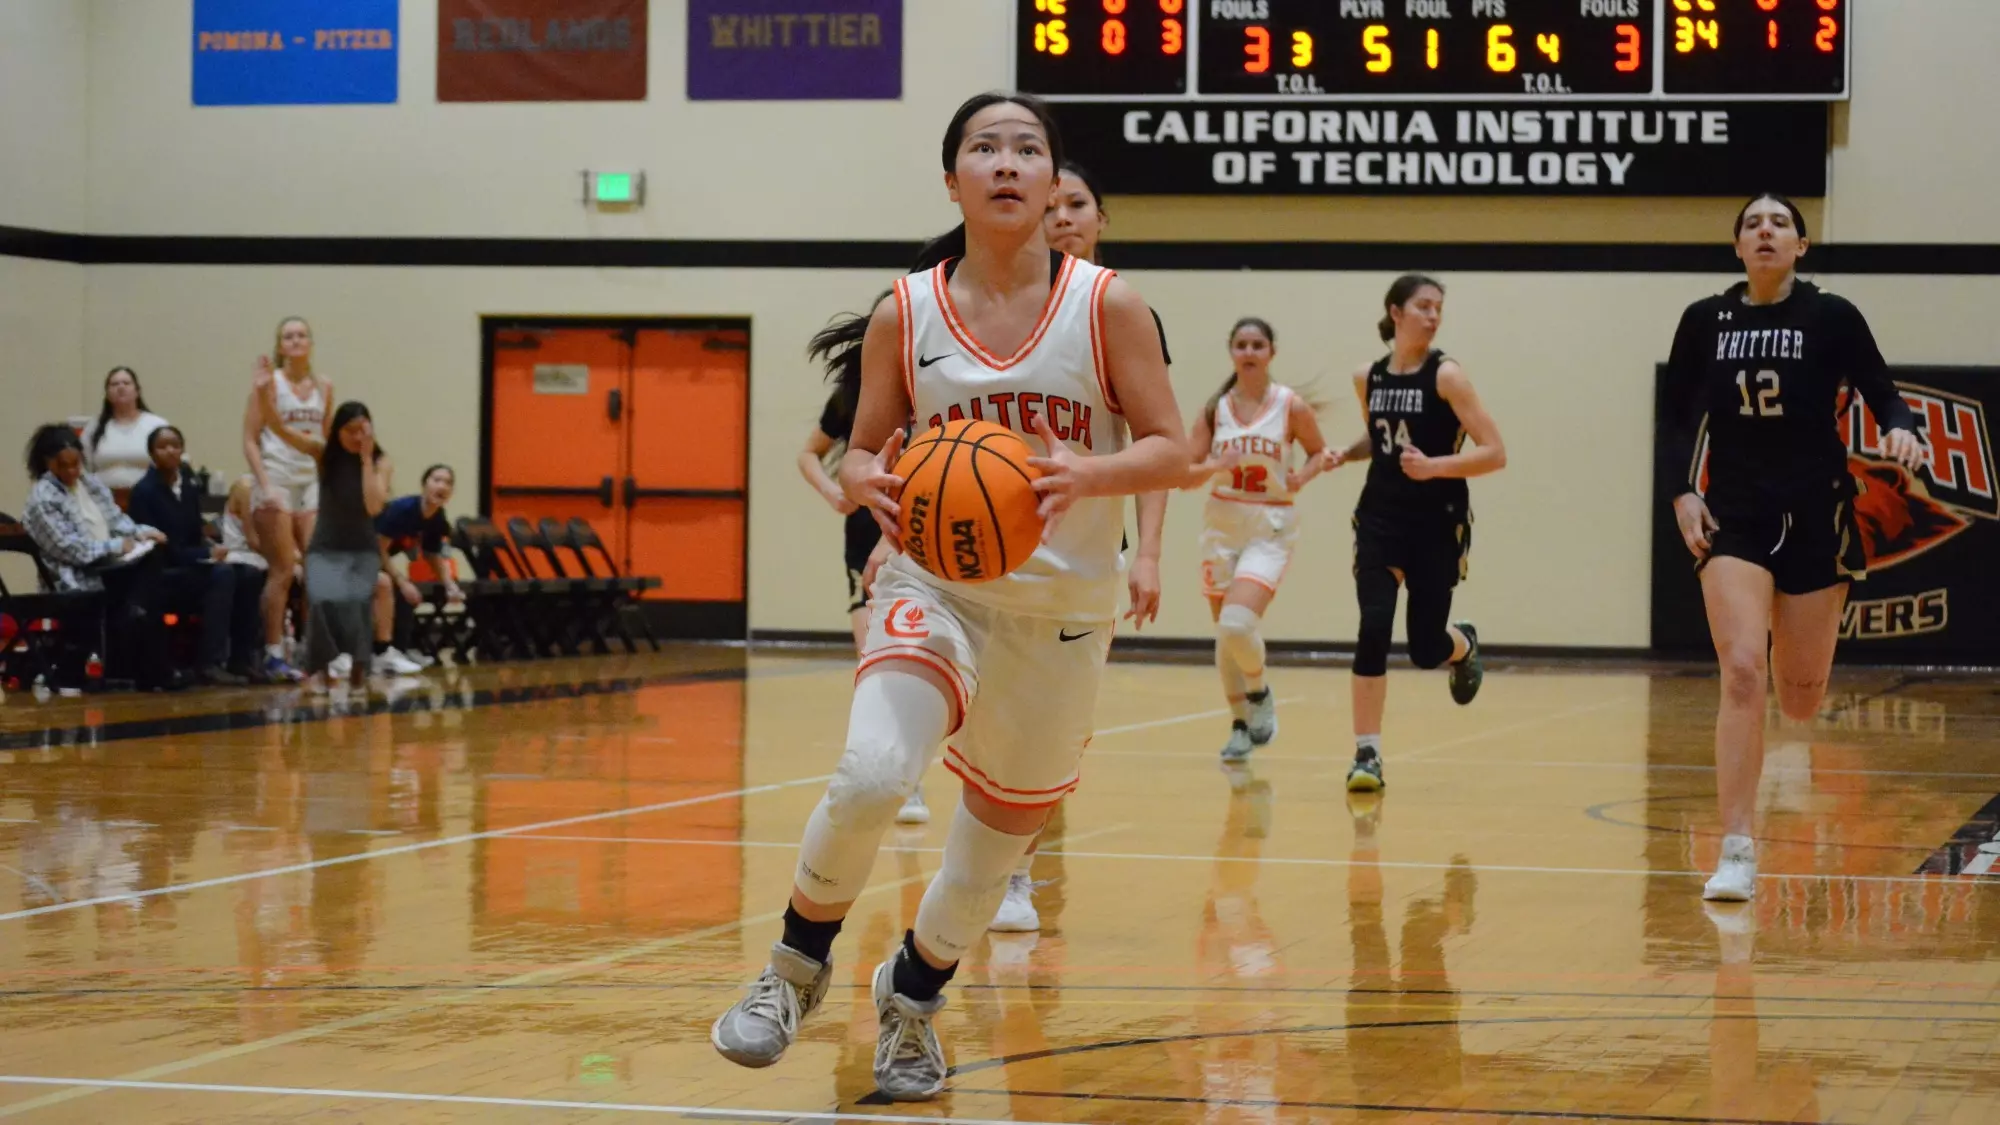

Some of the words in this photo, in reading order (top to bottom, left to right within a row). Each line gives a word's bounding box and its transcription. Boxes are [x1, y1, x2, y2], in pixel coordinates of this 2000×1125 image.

[1211, 0, 1269, 18] FOULS
[1341, 0, 1384, 18] PLYR
[1406, 0, 1451, 18] FOUL
[1472, 0, 1507, 17] PTS
[1581, 0, 1639, 17] FOULS
[200, 31, 284, 51] POMONA
[314, 29, 393, 50] PITZER
[453, 17, 631, 51] REDLANDS
[710, 13, 882, 47] WHITTIER
[1034, 19, 1069, 55] 15
[1102, 19, 1126, 55] 0
[1161, 19, 1182, 55] 3
[1675, 16, 1718, 52] 34
[1768, 20, 1778, 48] 1
[1815, 16, 1837, 51] 2
[1244, 26, 1270, 73] 3
[1292, 31, 1313, 67] 3
[1363, 25, 1392, 72] 5
[1427, 28, 1438, 69] 1
[1487, 25, 1516, 72] 6
[1537, 33, 1560, 63] 4
[1615, 25, 1640, 71] 3
[1123, 110, 1438, 144] CALIFORNIA
[1456, 110, 1730, 144] INSTITUTE
[1212, 152, 1276, 185] OF
[1293, 152, 1635, 186] TECHNOLOGY
[1716, 329, 1803, 360] WHITTIER
[1736, 369, 1784, 416] 12
[1375, 418, 1412, 455] 34
[1231, 464, 1268, 493] 12
[904, 495, 937, 576] ilson
[951, 520, 985, 579] NCAA
[1838, 587, 1949, 640] VERS
